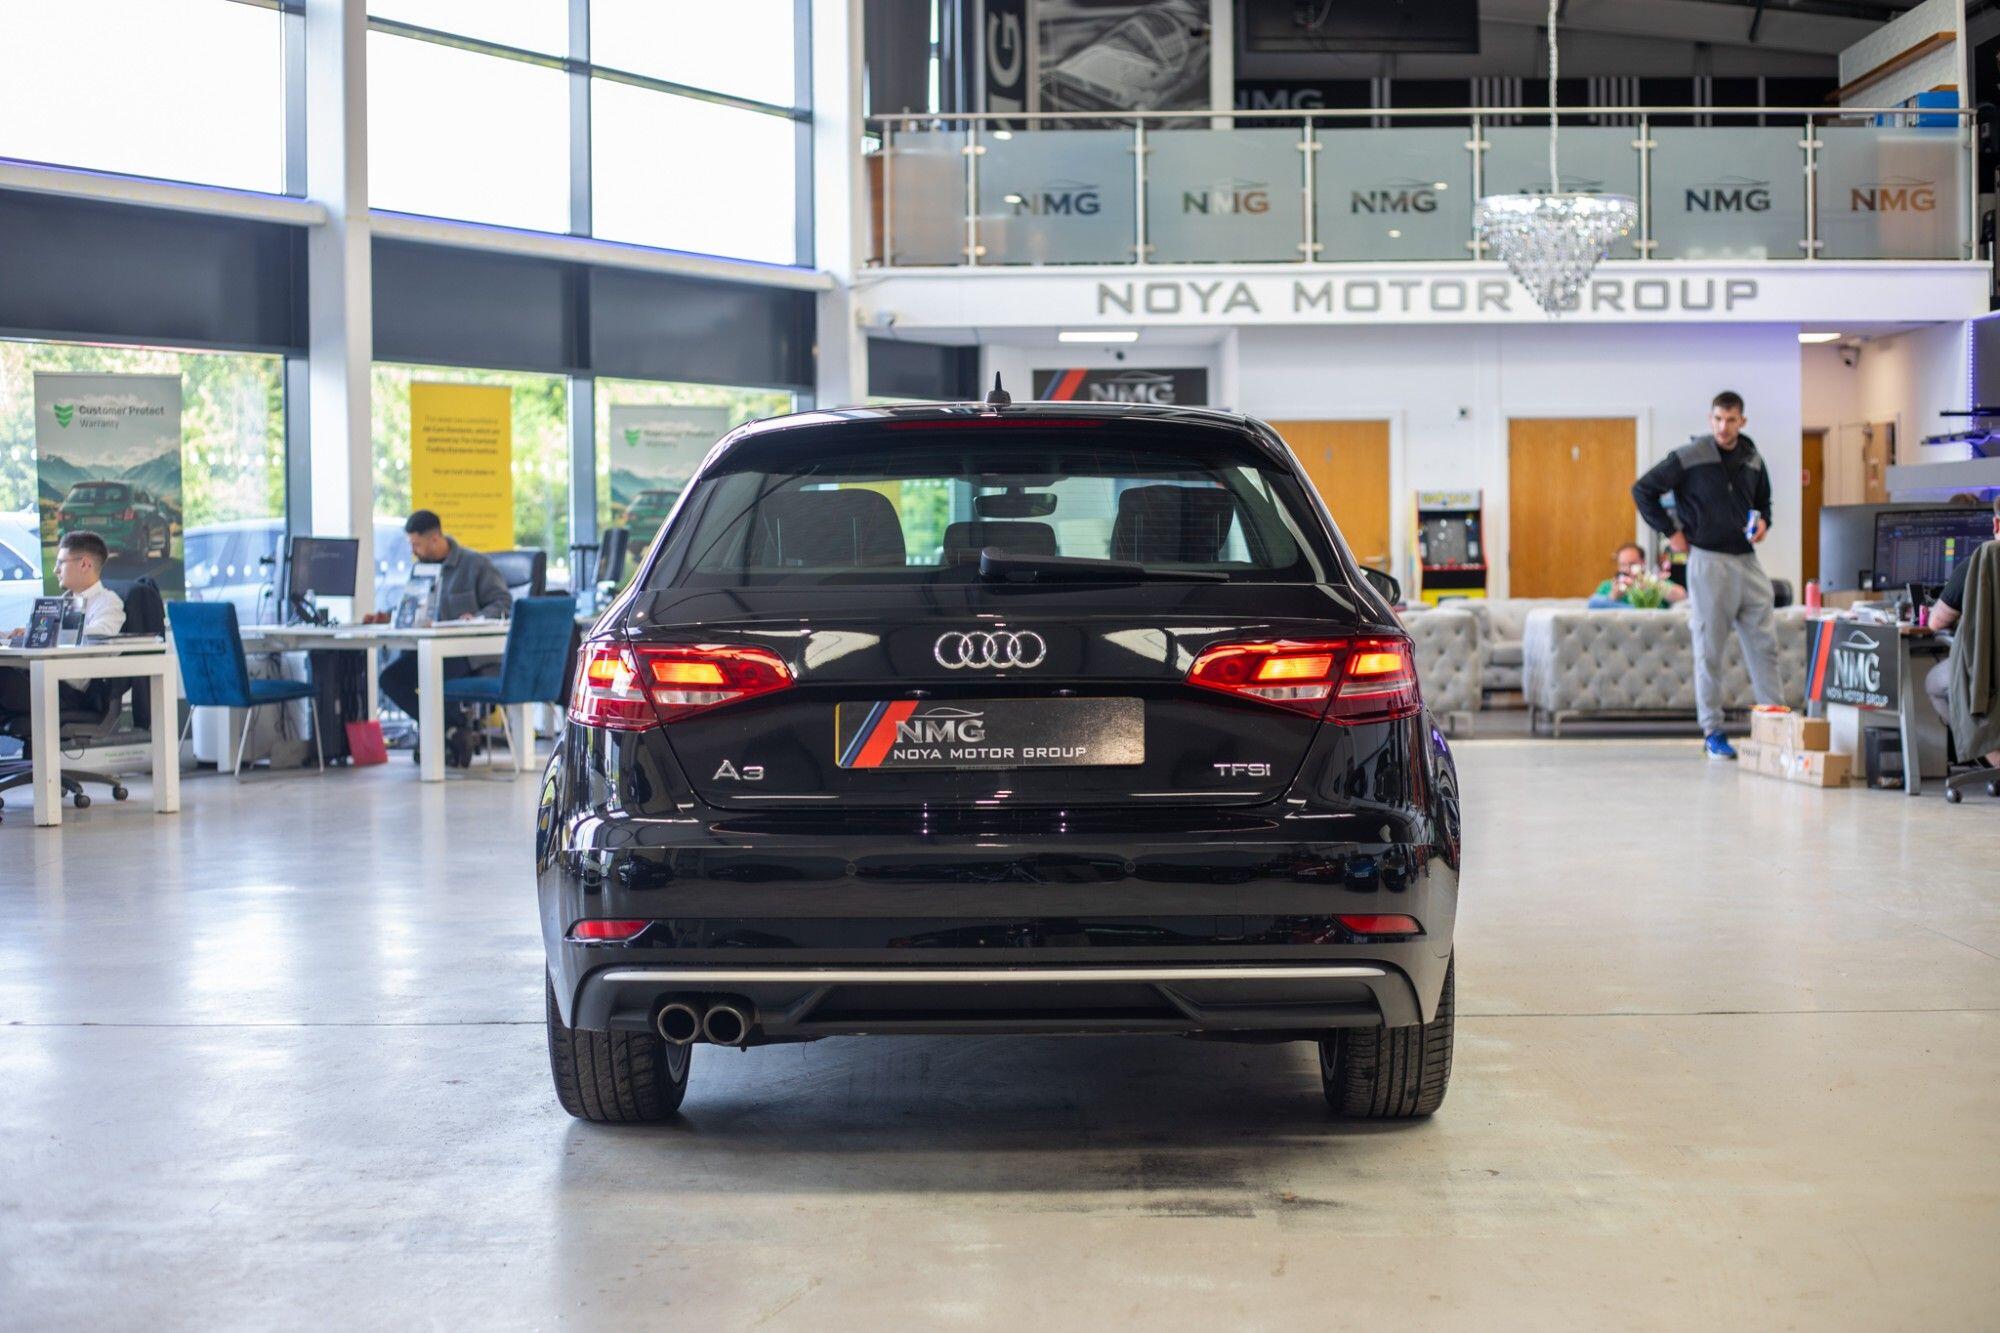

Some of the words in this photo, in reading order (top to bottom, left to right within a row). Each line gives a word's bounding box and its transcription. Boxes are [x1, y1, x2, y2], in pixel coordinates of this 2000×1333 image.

[1011, 191, 1100, 216] NMG
[1182, 191, 1270, 214] NMG
[1351, 190, 1439, 213] NMG
[1685, 188, 1770, 212] NMG
[1851, 188, 1937, 212] NMG
[1097, 282, 1261, 315] NOYA
[1293, 280, 1512, 313] MOTOR
[1089, 383, 1175, 404] NMG
[79, 405, 126, 415] Customer
[128, 405, 165, 416] Protect
[80, 419, 119, 430] Warranty
[1833, 648, 1880, 692] NMG
[895, 719, 985, 743] NMG
[893, 749, 942, 760] NOYA
[950, 748, 1015, 759] MOTOR
[1023, 746, 1086, 758] GROUP
[712, 759, 764, 780] A3
[1213, 763, 1270, 776] TFSI
